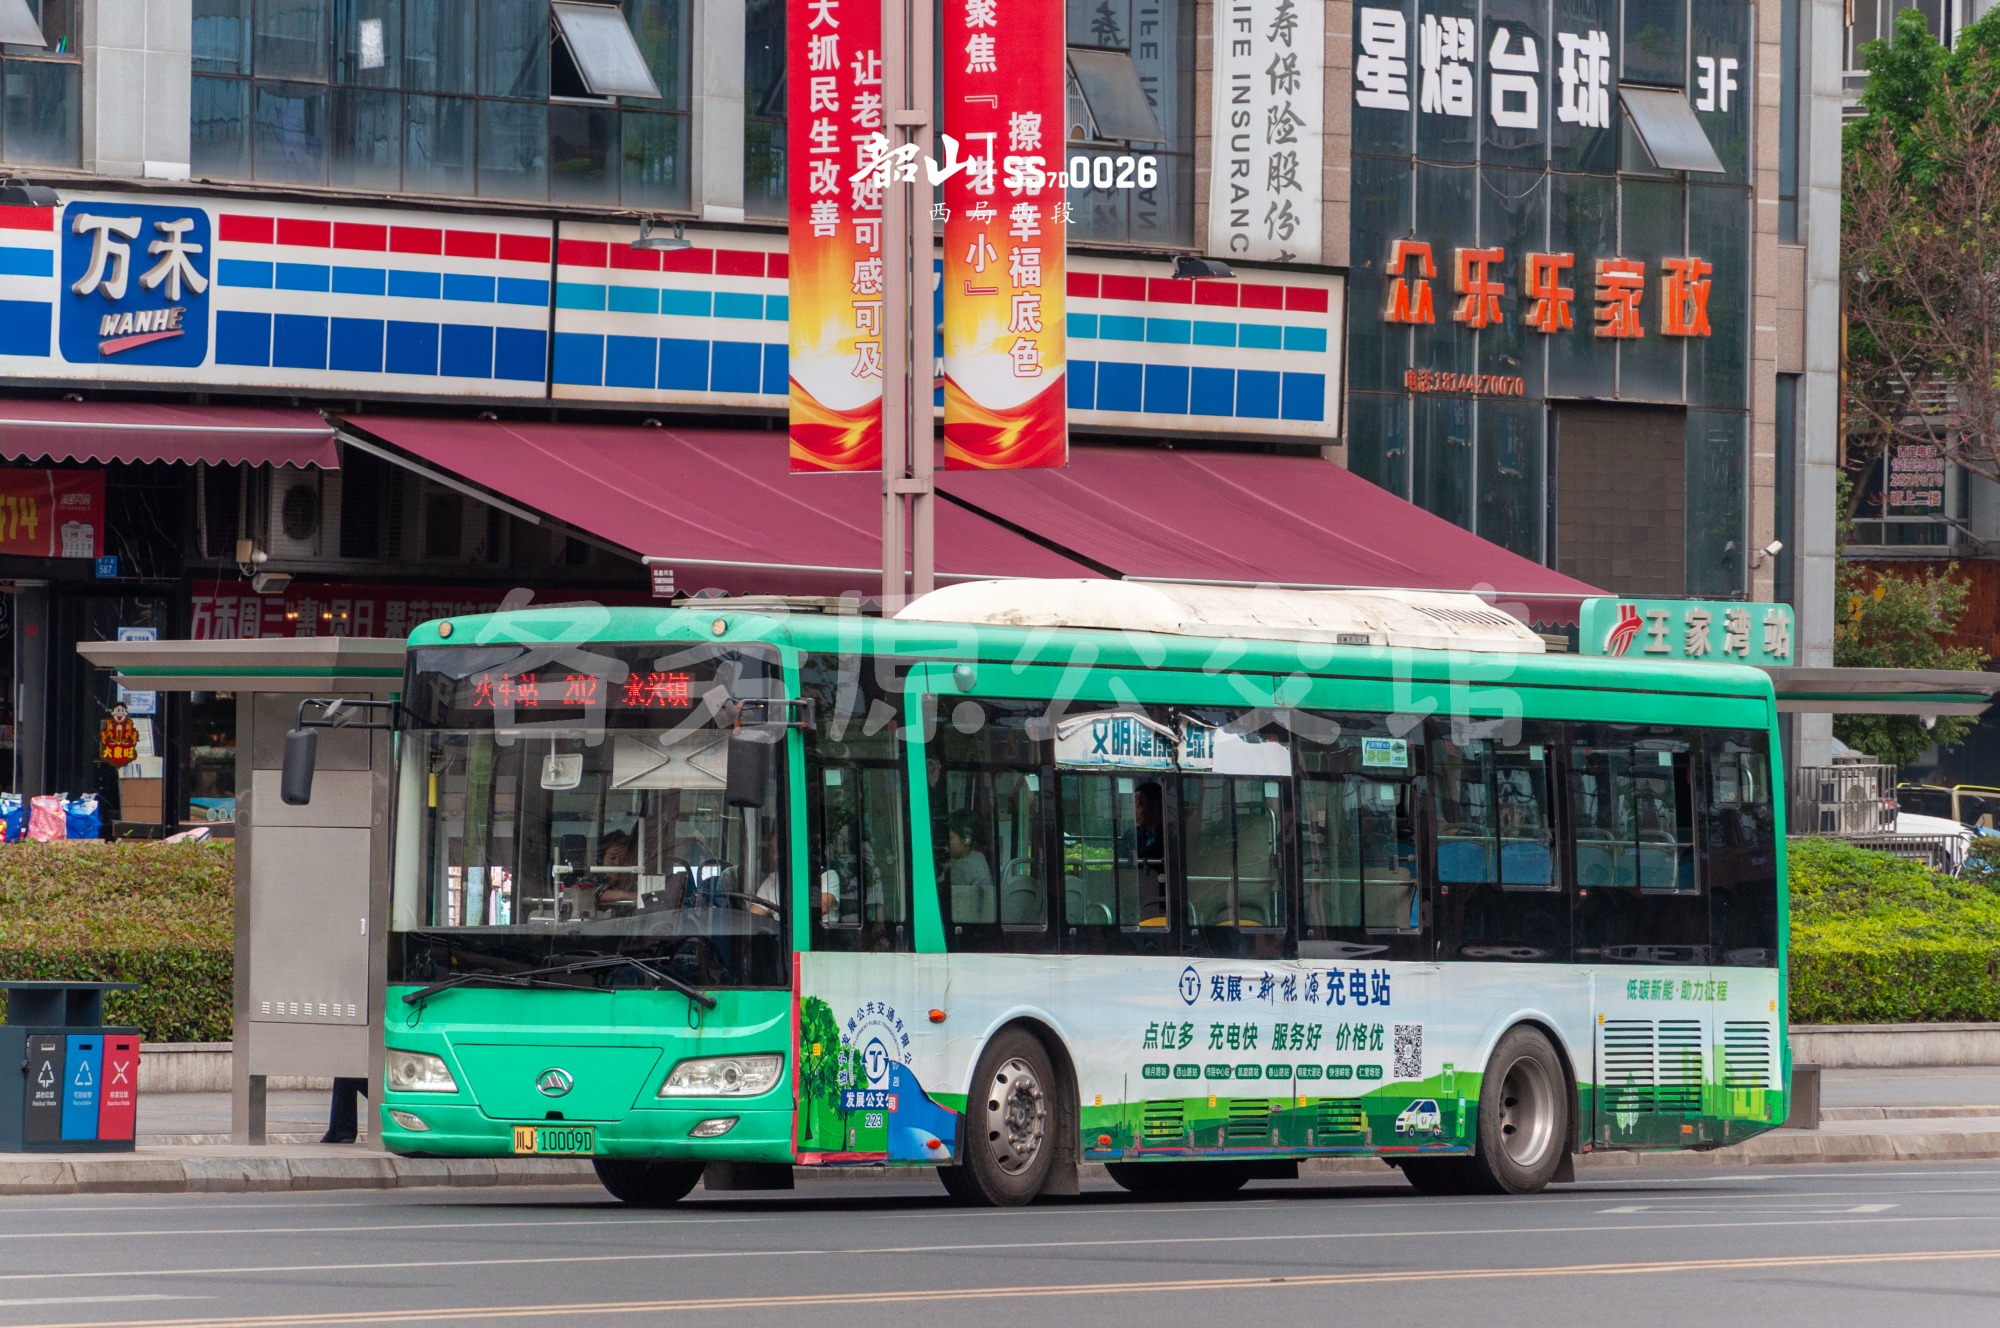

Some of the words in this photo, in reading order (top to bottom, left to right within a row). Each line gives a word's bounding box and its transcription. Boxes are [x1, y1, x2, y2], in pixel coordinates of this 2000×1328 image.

[1233, 0, 1252, 57] IFE
[1356, 7, 1610, 129] 星熠台球
[1696, 56, 1738, 112] 3F
[807, 0, 841, 238] 大抓民生改善
[1264, 0, 1306, 263] 寿保险股份
[72, 213, 209, 301] 万禾
[1384, 239, 1713, 338] 众乐乐家政
[99, 306, 186, 337] WANHE
[99, 565, 113, 574] 587
[1644, 607, 1792, 657] 王家湾站
[473, 673, 539, 707] 火车站
[563, 675, 597, 705] 202
[622, 672, 690, 707] 永兴镇
[1142, 1021, 1195, 1050] 点位多
[1207, 1021, 1259, 1051] 充电快
[1271, 1022, 1323, 1051] 服务好
[1335, 1022, 1385, 1051] 价格优
[865, 1113, 882, 1128] 223
